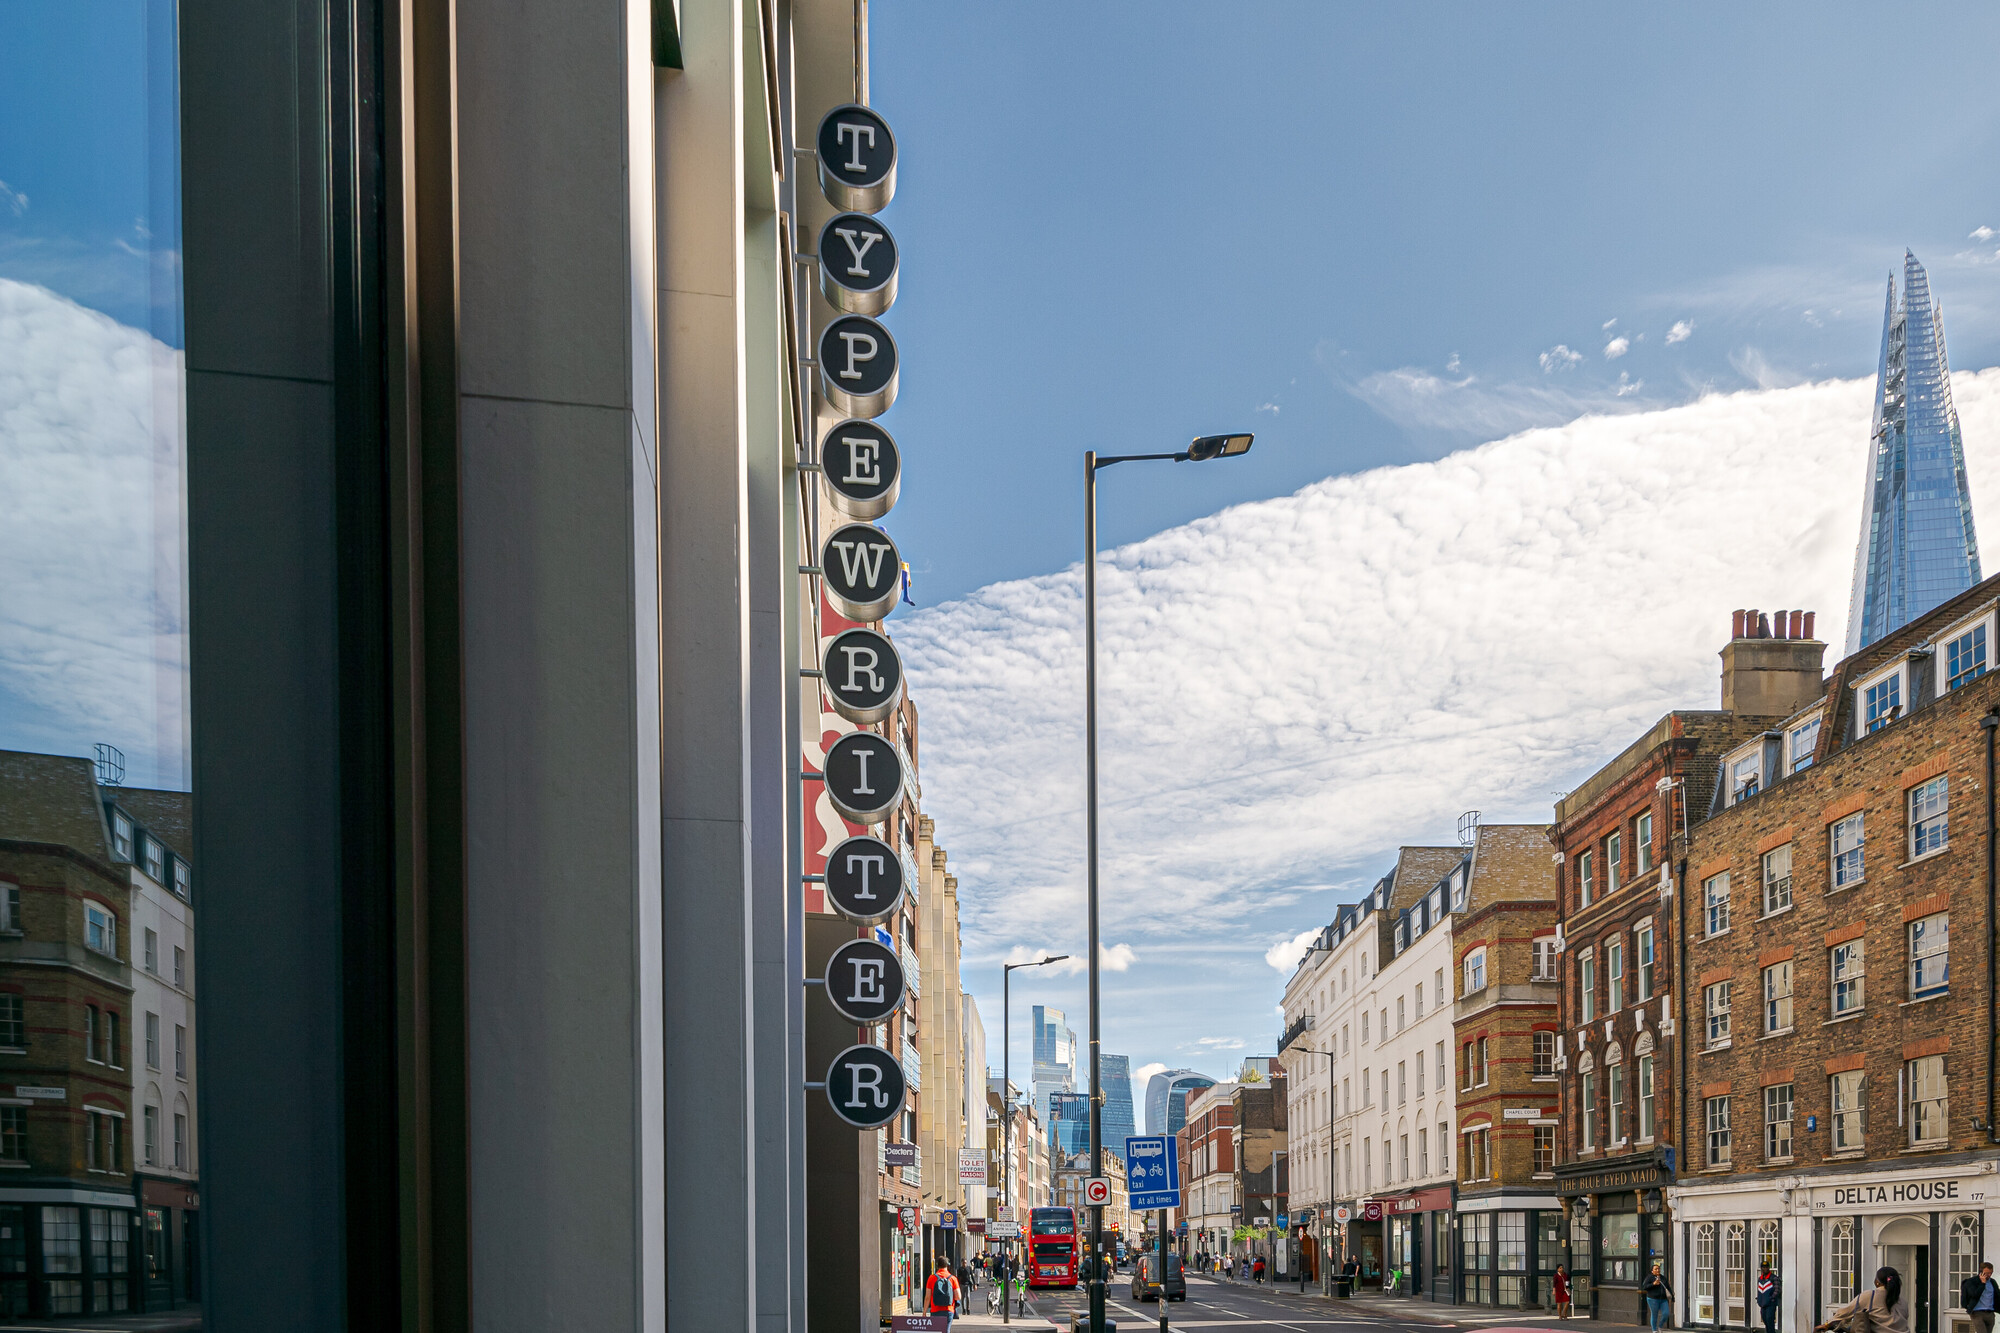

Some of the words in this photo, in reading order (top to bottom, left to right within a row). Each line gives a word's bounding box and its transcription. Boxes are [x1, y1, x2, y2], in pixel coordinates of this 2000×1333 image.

[886, 1147, 914, 1156] Dexters
[1132, 1180, 1144, 1189] taxi
[1560, 1179, 1576, 1192] THE
[1579, 1176, 1600, 1190] BLUE
[1604, 1171, 1627, 1187] EYED
[1631, 1168, 1658, 1184] MAID
[1835, 1186, 1888, 1205] DELTA
[1893, 1181, 1959, 1202] HOUSE
[1971, 1192, 1984, 1201] 177
[1138, 1197, 1145, 1205] At
[1147, 1196, 1155, 1205] all
[1156, 1195, 1172, 1204] times
[906, 1318, 933, 1326] COSTA
